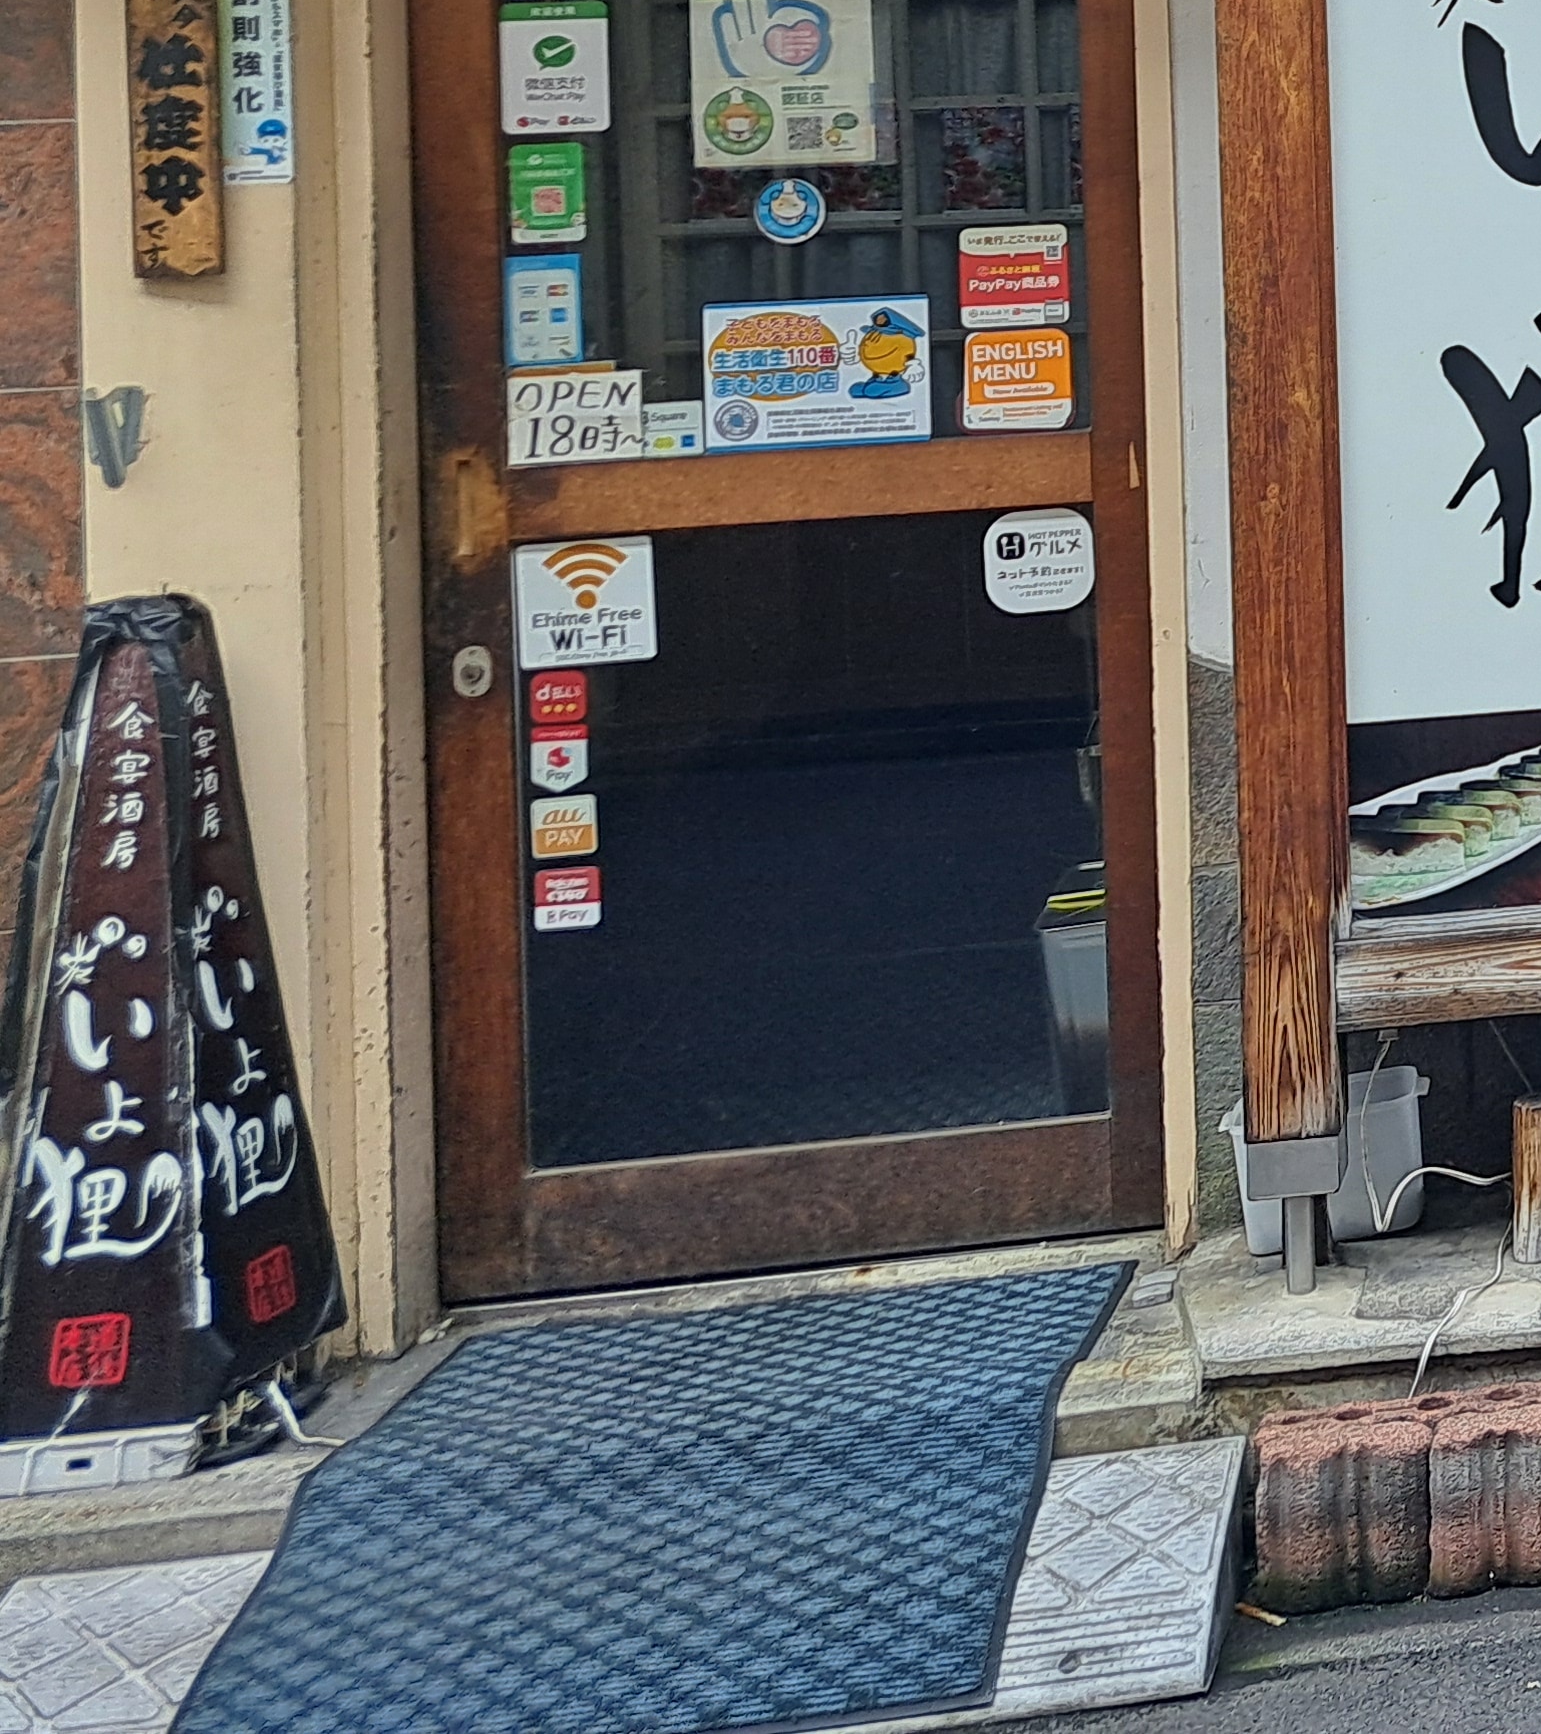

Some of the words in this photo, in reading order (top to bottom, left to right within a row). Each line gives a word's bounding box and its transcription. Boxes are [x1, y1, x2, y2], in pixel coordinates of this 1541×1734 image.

[968, 275, 1060, 293] PayPay商品券
[713, 345, 838, 370] 生活衛生110番
[972, 339, 1063, 363] ENGLISH
[973, 361, 1036, 383] MENU
[712, 371, 840, 397] まもる君の店
[514, 380, 637, 414] OPEN
[1048, 528, 1082, 539] PEPPER
[1029, 537, 1083, 558] グルメ
[532, 607, 592, 629] Ehime
[598, 607, 643, 623] Free
[549, 624, 627, 651] Wi-Fi
[186, 679, 223, 839] 食宴酒房
[101, 700, 156, 871] 食宴酒房
[542, 808, 587, 826] au
[545, 828, 584, 848] PAY
